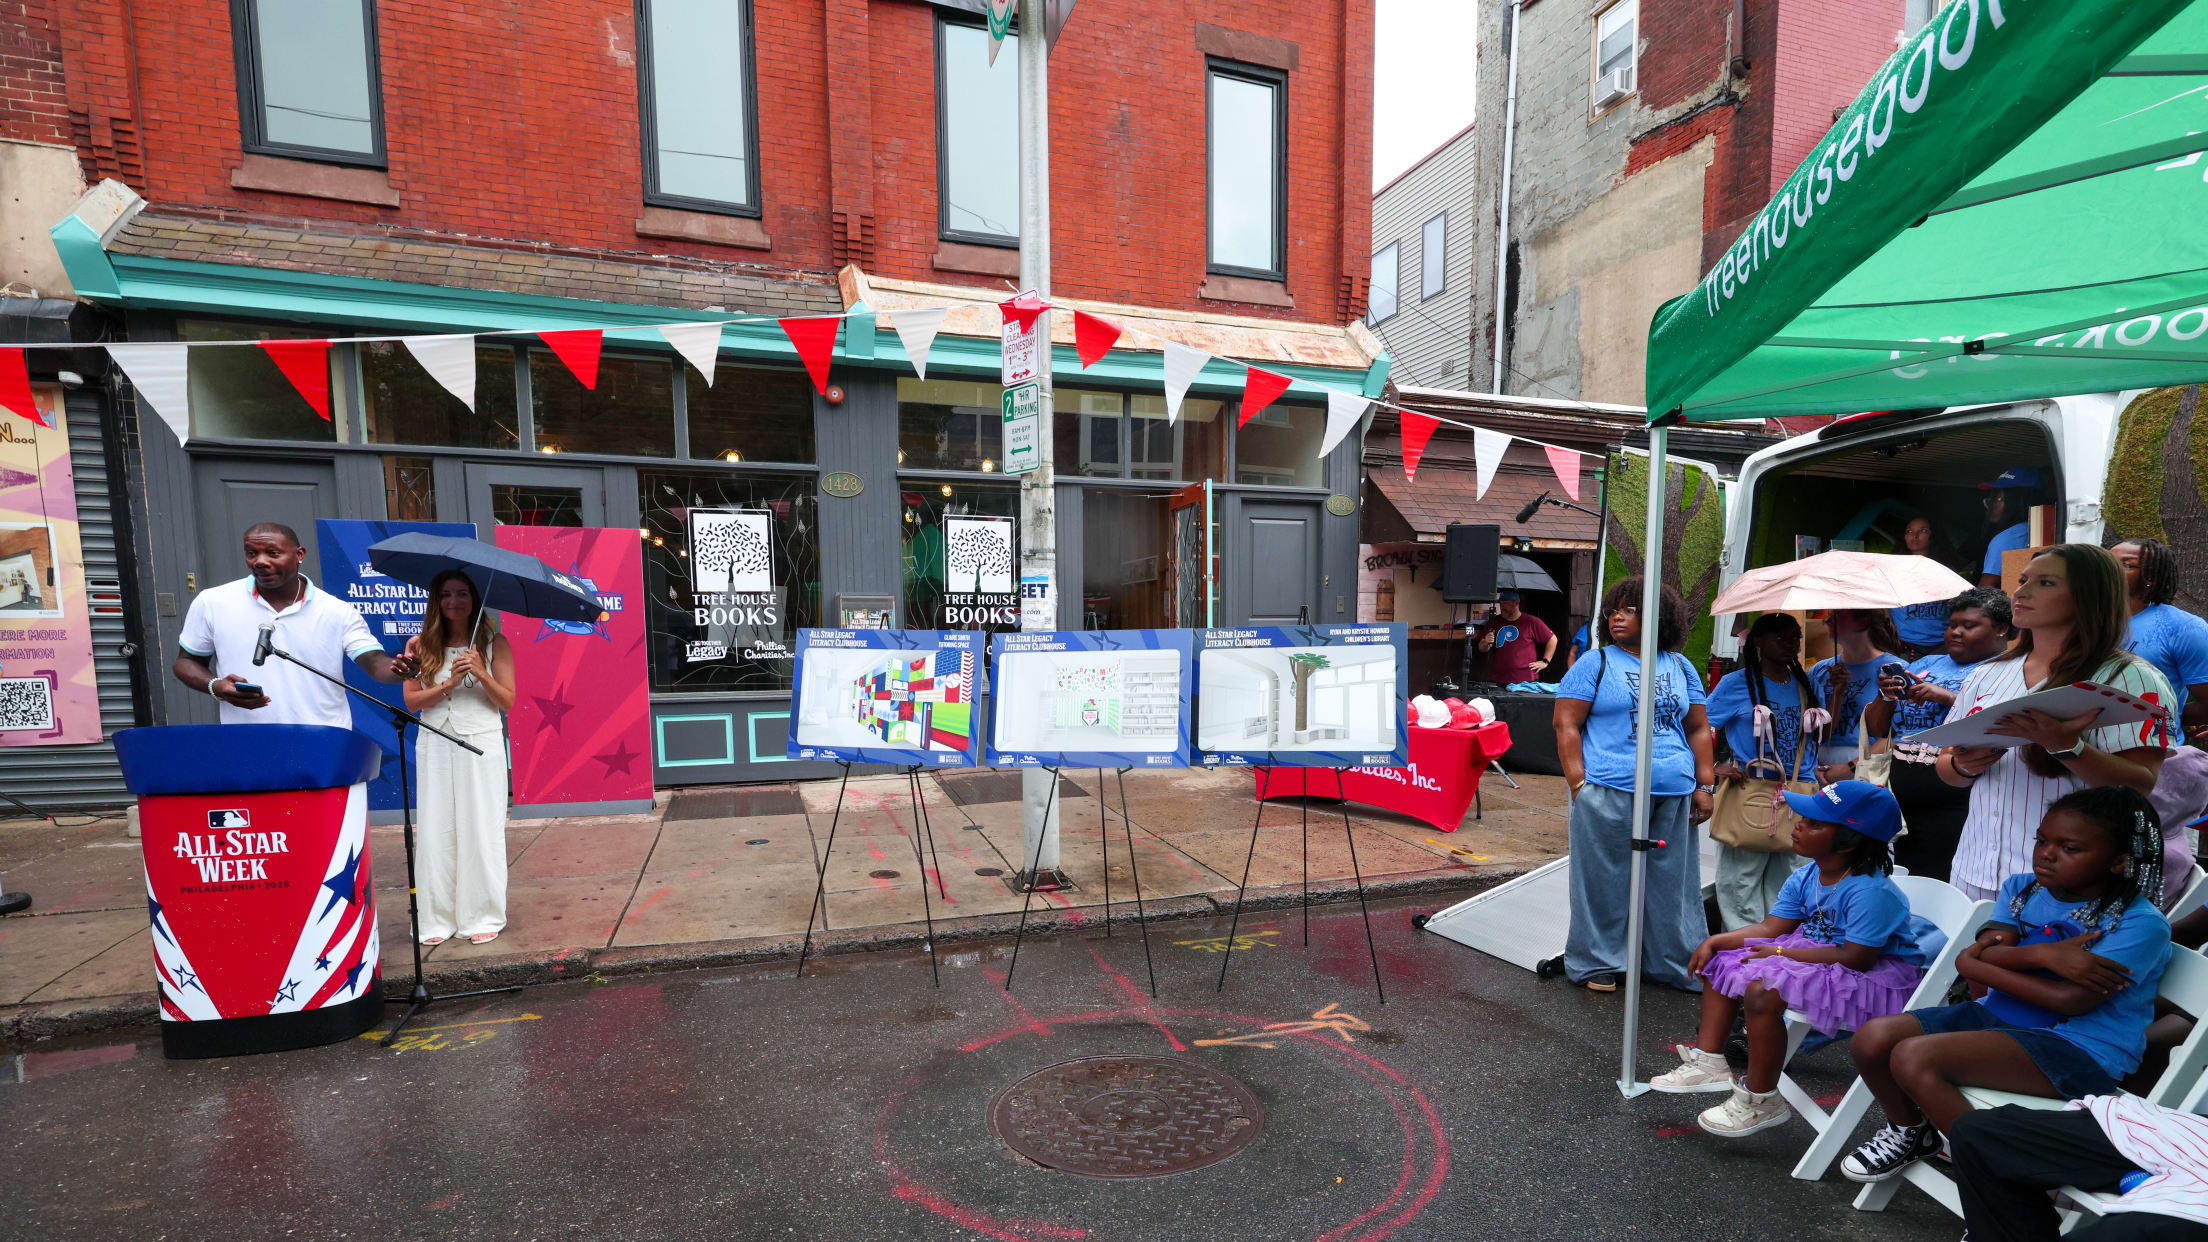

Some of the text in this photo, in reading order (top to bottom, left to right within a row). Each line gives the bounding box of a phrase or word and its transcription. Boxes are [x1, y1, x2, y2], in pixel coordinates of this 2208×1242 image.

[1005, 337, 1036, 355] WEDNESDAY
[1020, 390, 1030, 402] HR
[1006, 396, 1012, 417] 2
[1014, 402, 1037, 416] PARKING
[828, 478, 858, 491] 1428
[1364, 551, 1413, 572] BROWN
[348, 583, 374, 598] ALL
[375, 583, 407, 598] STAR
[692, 594, 777, 605] TREE HOUSE
[944, 594, 1017, 605] TREE HOUSE
[694, 607, 778, 627] BOOKS
[945, 606, 1017, 624] BOOKS
[28, 630, 68, 640] MORE
[398, 626, 423, 634] BOOK
[810, 630, 856, 638] ALL STAR LEGACY
[1204, 630, 1258, 638] ALL STAR LEGACY
[810, 638, 868, 648] LITERACY CLUBHOUSE
[1004, 634, 1054, 642] ALL STAR LEGACY
[1205, 638, 1272, 648] LITERACY CLUBHOUSE
[686, 644, 728, 658] Legacy
[754, 640, 786, 651] Phillies
[1004, 642, 1066, 650] LITERACY CLUBHOUSE
[1407, 763, 1442, 791] Inc.
[173, 830, 290, 858] ALL STAR
[191, 857, 269, 883] WEEK
[180, 880, 290, 894] PHILADELPHIA 2026
